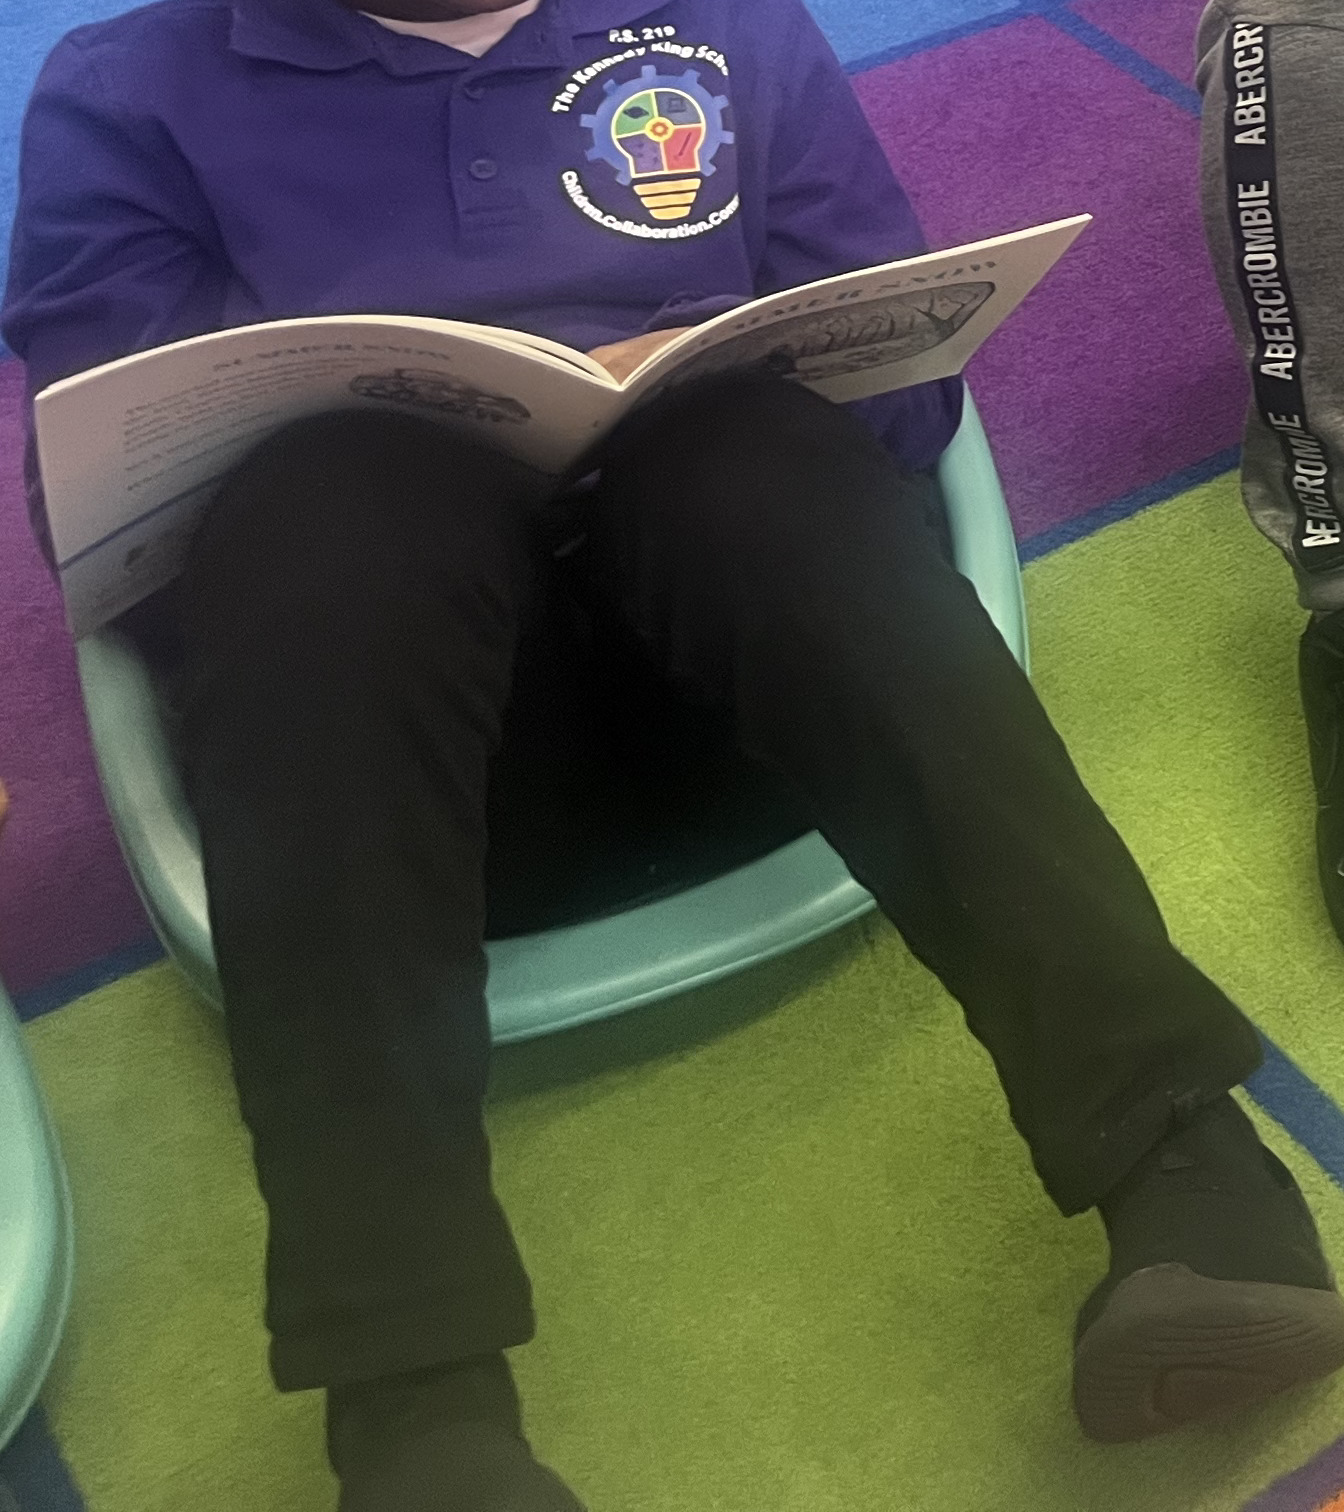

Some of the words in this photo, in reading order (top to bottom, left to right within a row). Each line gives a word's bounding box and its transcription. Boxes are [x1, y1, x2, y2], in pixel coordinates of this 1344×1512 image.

[608, 29, 639, 43] P.S.
[642, 25, 676, 40] 219
[551, 83, 580, 113] The
[572, 46, 647, 85] Kennedy
[651, 41, 695, 58] King
[1237, 180, 1297, 380] ABERCROMBIE
